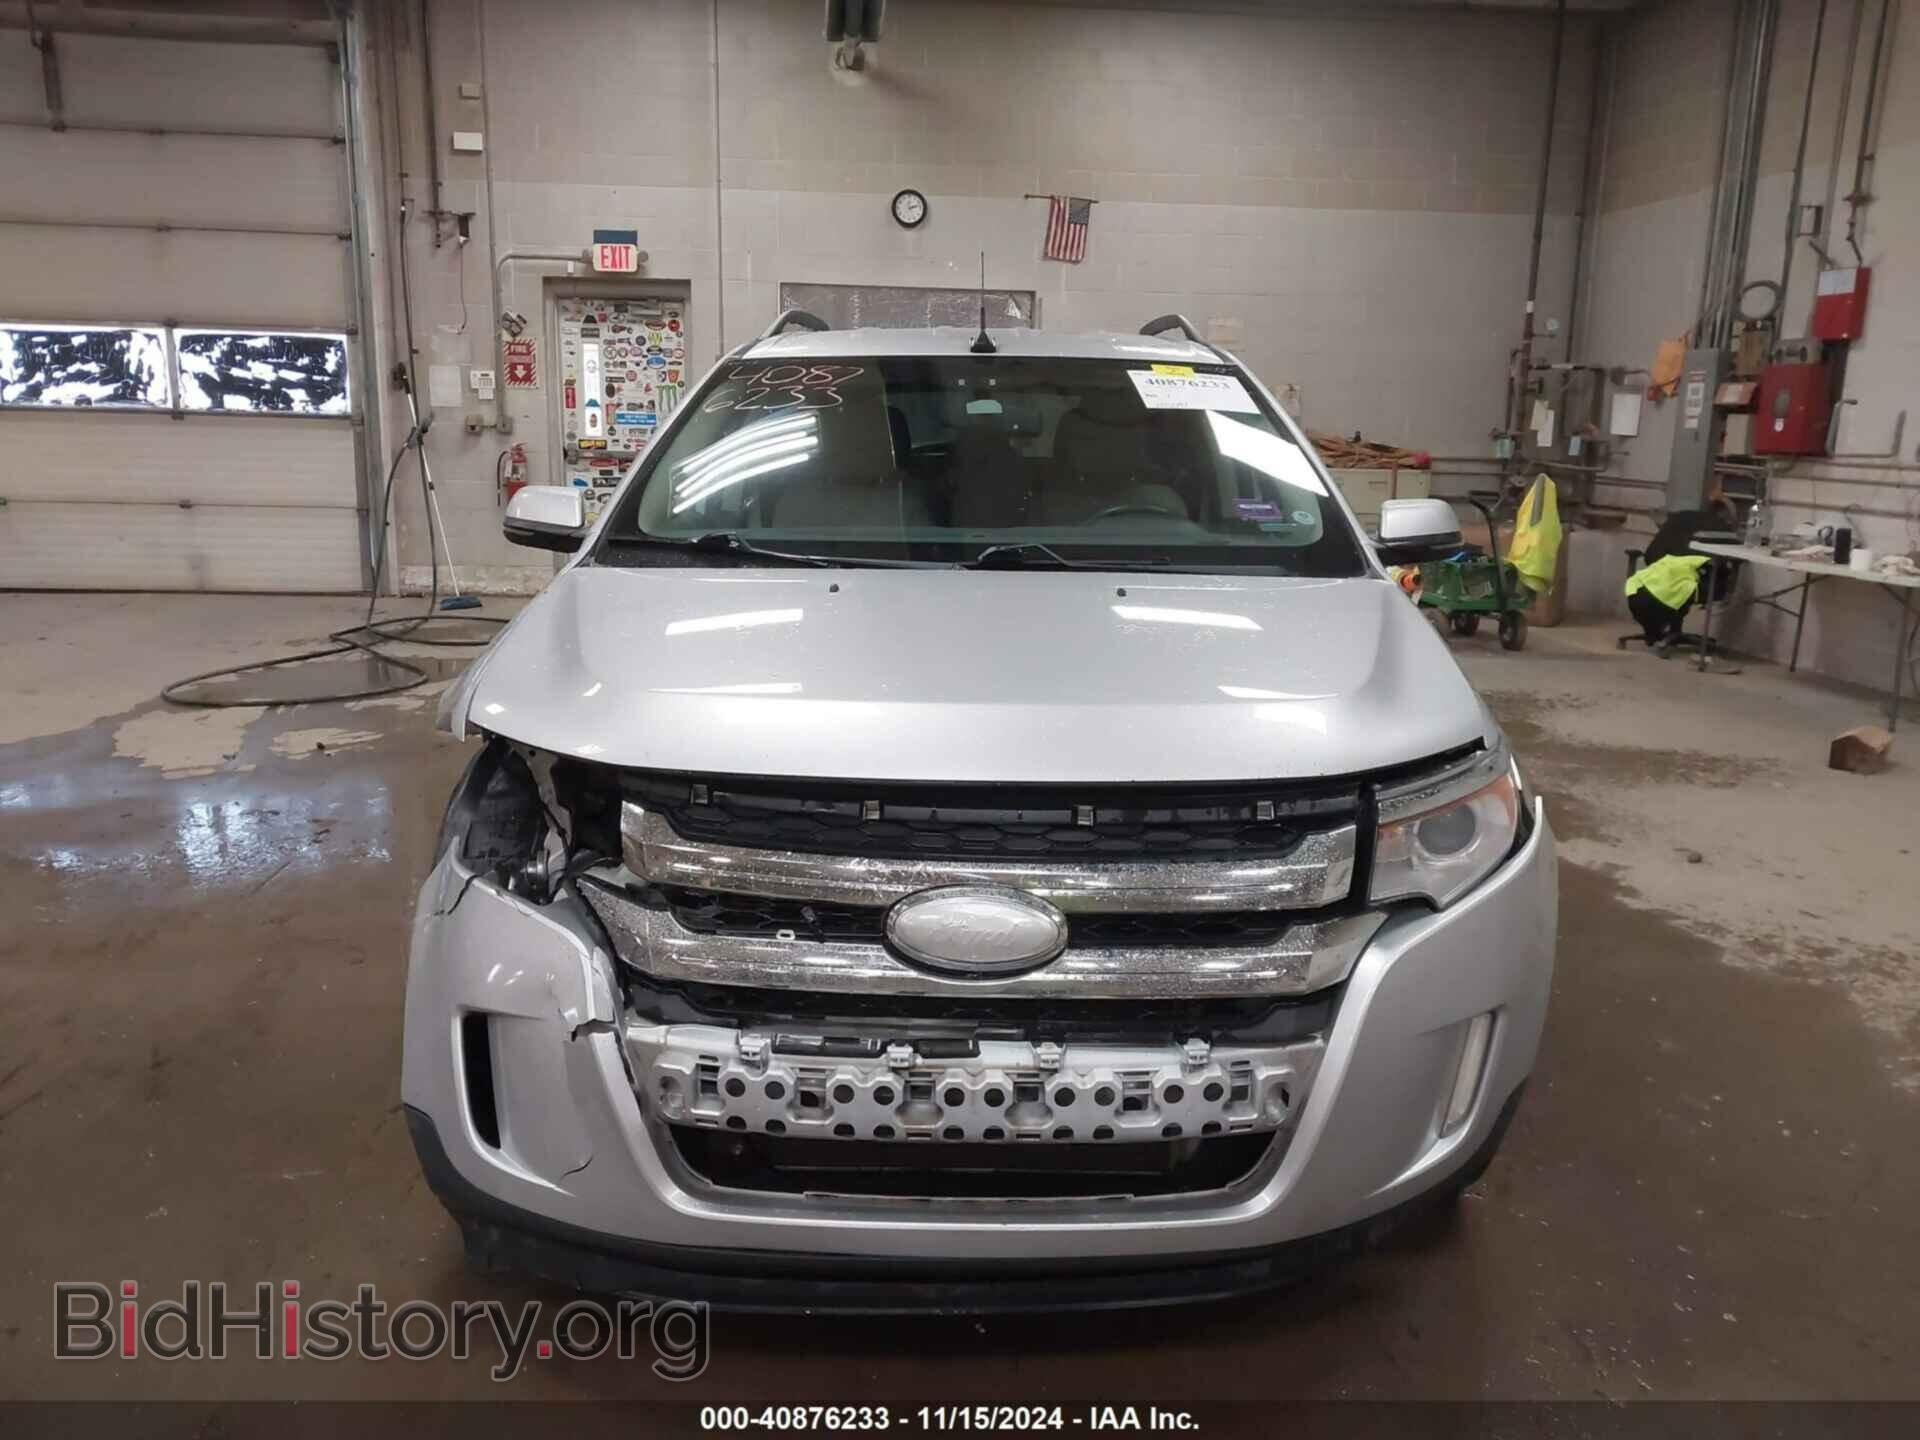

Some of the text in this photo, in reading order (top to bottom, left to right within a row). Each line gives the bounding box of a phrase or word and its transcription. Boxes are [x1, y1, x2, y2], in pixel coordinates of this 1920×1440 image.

[600, 245, 631, 269] EXIT
[510, 344, 527, 353] FIRE
[728, 364, 864, 385] 4087
[1144, 377, 1231, 390] 40876233
[702, 386, 843, 413] 6233
[928, 916, 1018, 947] Ford
